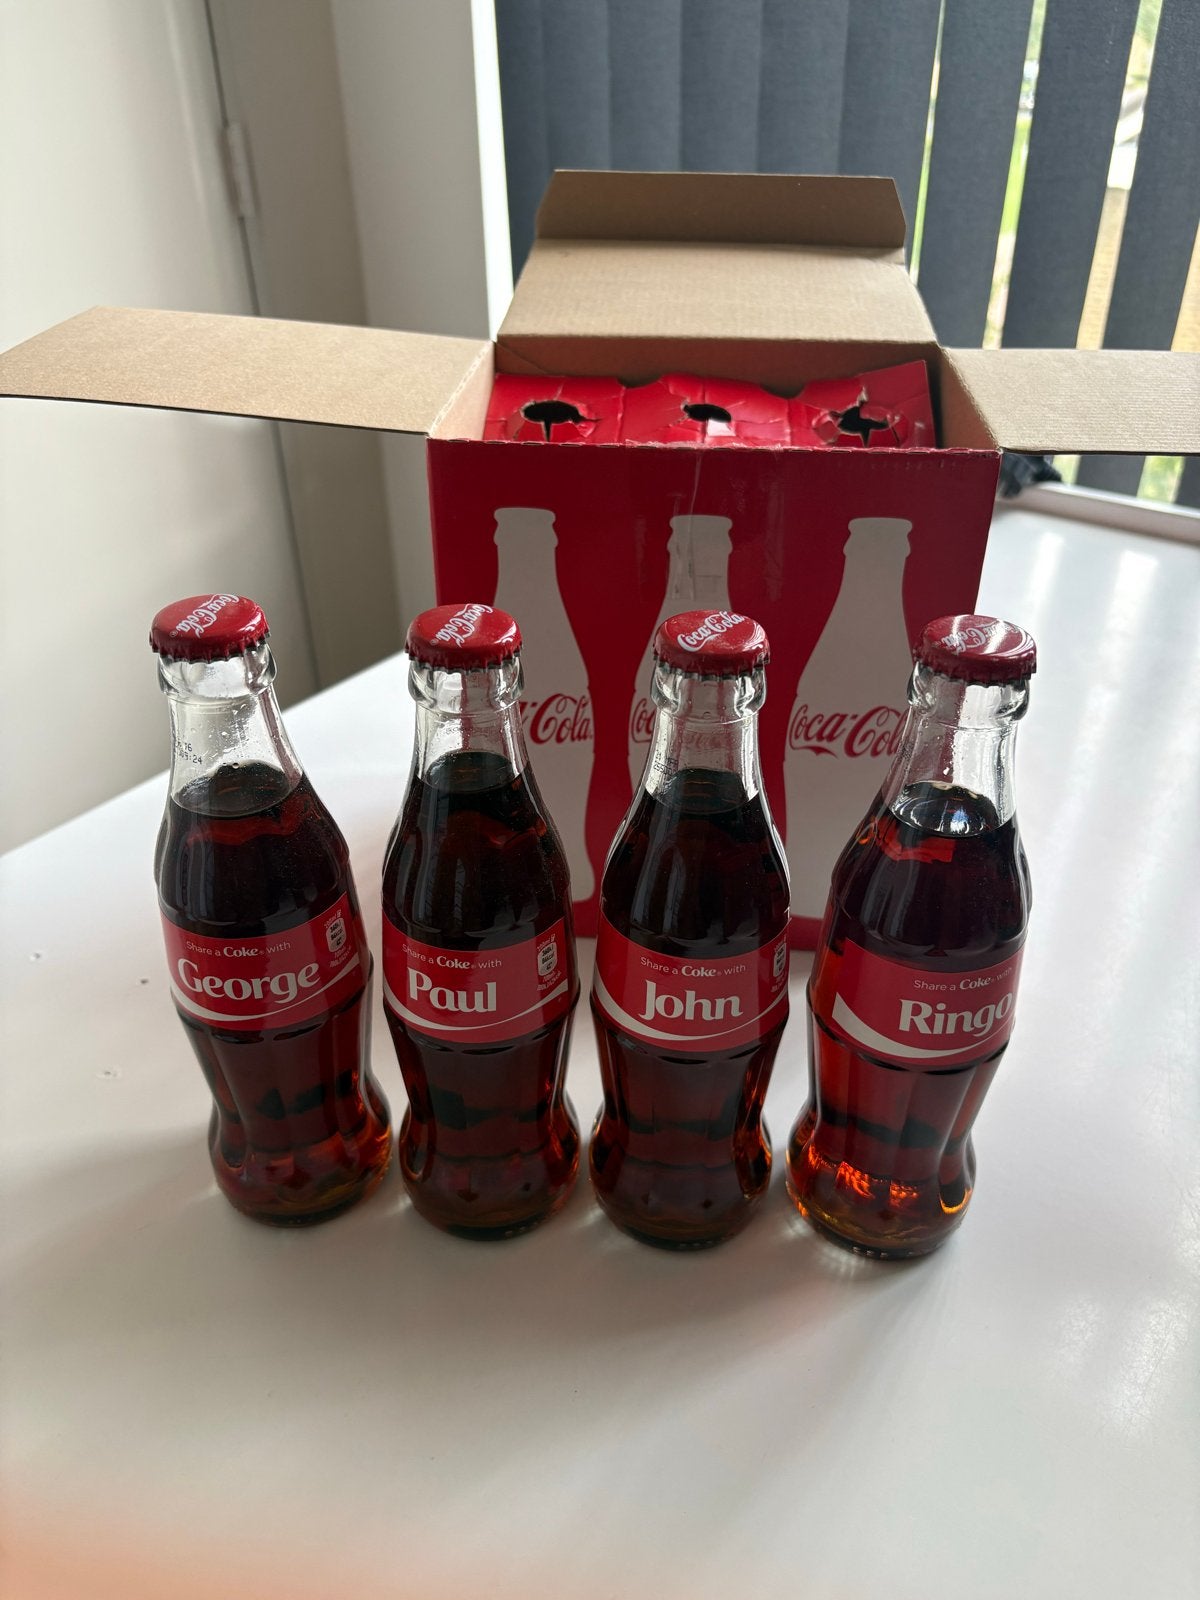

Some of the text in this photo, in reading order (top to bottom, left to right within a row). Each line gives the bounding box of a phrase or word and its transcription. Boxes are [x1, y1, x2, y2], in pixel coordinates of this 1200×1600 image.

[175, 593, 240, 639] Coca-Cola
[435, 603, 494, 648] Coca-Cola
[677, 610, 745, 652] Coca-Cola
[186, 940, 291, 958] Share a Coke with
[402, 943, 502, 970] Share a Coke with
[640, 956, 746, 977] Share a Coke with
[177, 958, 321, 1004] George
[407, 966, 497, 1013] Paul
[638, 979, 744, 1021] John
[914, 979, 947, 991] Share
[959, 977, 991, 990] Coke
[898, 993, 1013, 1037] Ringo
